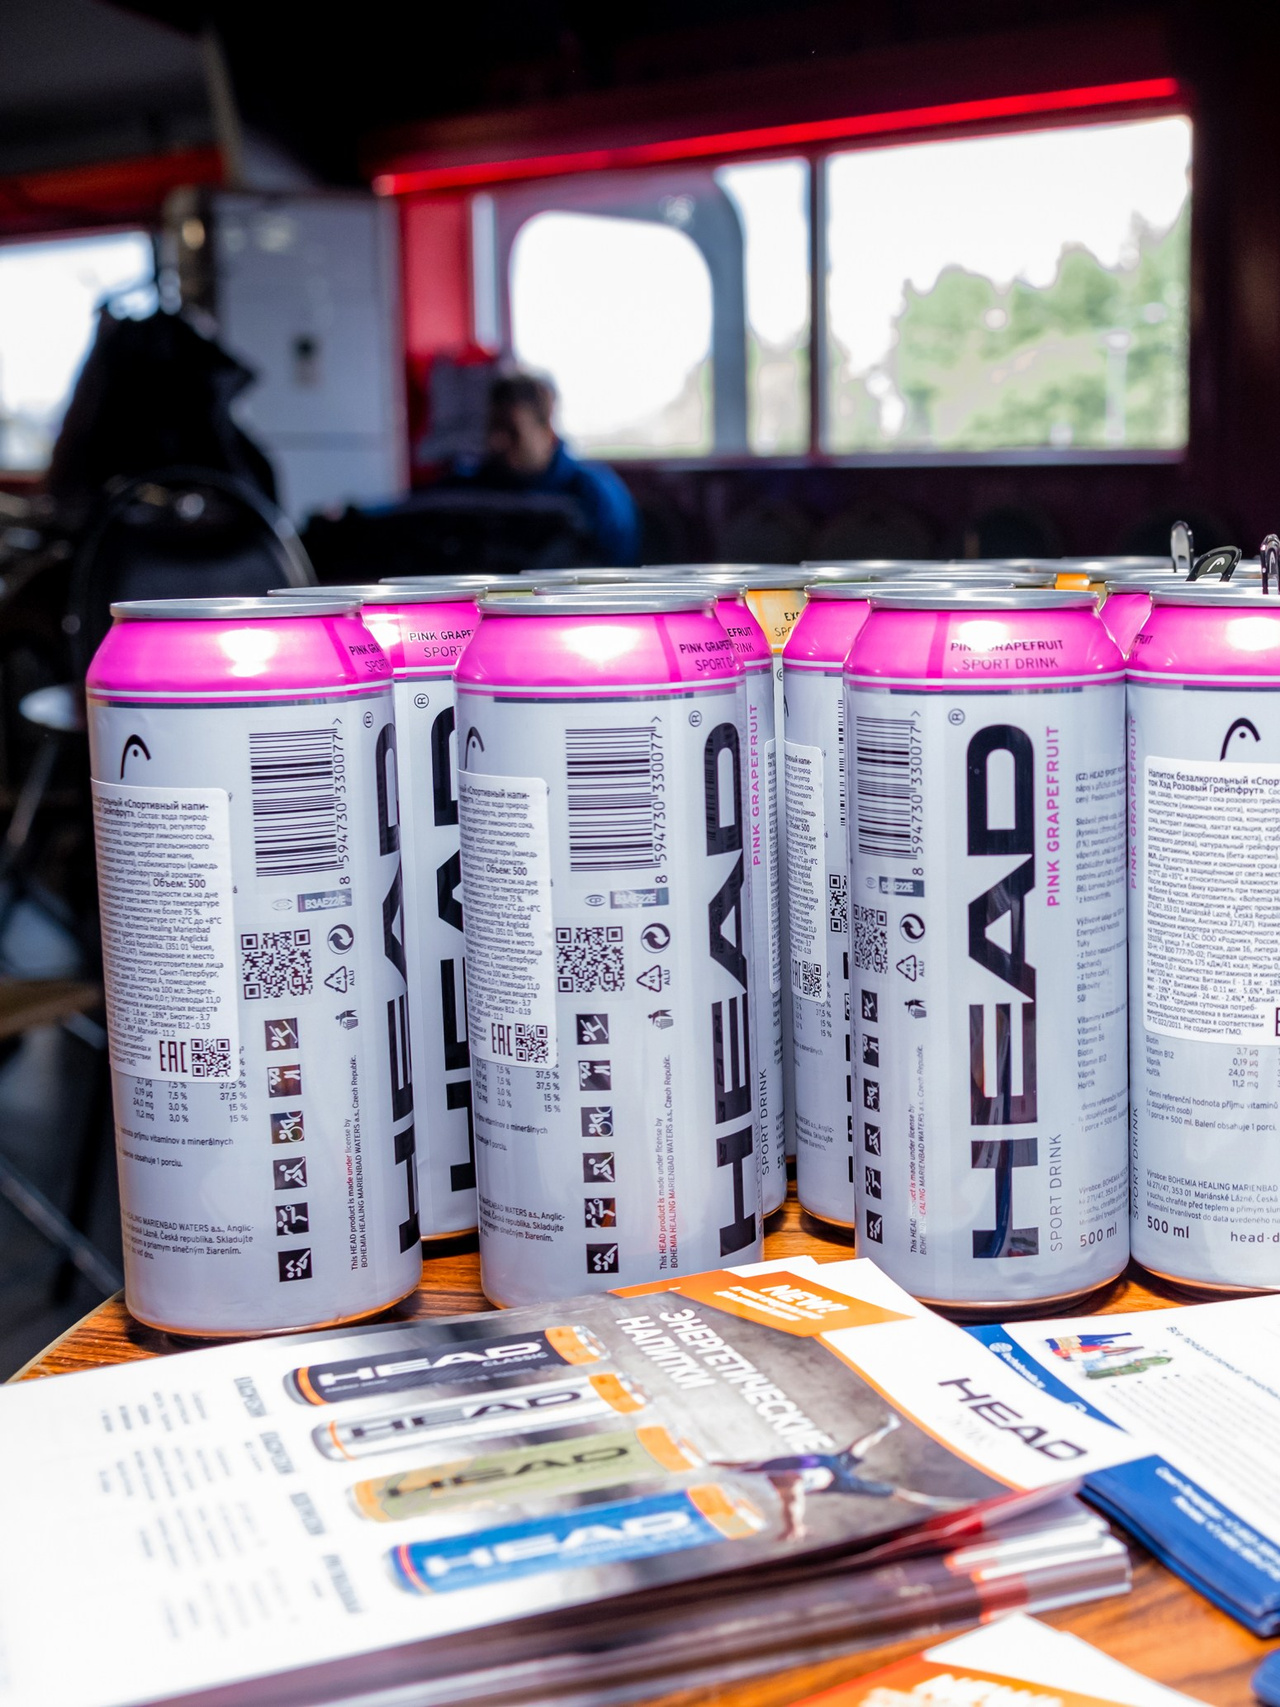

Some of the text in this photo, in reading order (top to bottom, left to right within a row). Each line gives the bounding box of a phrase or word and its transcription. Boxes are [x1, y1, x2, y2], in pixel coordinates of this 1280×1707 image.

[409, 631, 438, 643] PINK
[727, 626, 754, 638] EFRUIT
[349, 645, 368, 656] PINK
[679, 643, 705, 655] PINK
[695, 657, 726, 672] SPORT
[962, 656, 1059, 671] SPORT DRINK
[748, 704, 761, 866] PINK GRAPEFRUIT
[1148, 769, 1175, 780] Напиток
[1176, 772, 1248, 785] безалкогольный
[1148, 779, 1158, 787] ток
[1159, 780, 1172, 789] Хэд
[1173, 782, 1207, 792] Розовый
[332, 732, 350, 885] 8 594730 330077
[650, 732, 667, 884] 8 594730 330077
[910, 725, 924, 877] 8 594730 330077
[1046, 726, 1060, 907] PINK GRAPEFRUIT
[153, 878, 206, 889] Объем: 500
[704, 721, 760, 1258] HEAD
[966, 723, 1039, 1259] HEAD
[350, 1055, 358, 1085] Republic.
[663, 1055, 671, 1085] Republic.
[351, 1088, 359, 1108] Czech
[664, 1088, 672, 1108] Czech
[759, 1069, 771, 1176] SPORT DRINK
[655, 1128, 663, 1152] license
[355, 1156, 364, 1198] MARIENBAD
[667, 1155, 676, 1198] MARIENBAD
[1049, 1133, 1063, 1252] SPORT DRINK
[1168, 1174, 1197, 1187] BOHEMIA
[1198, 1180, 1230, 1191] HEALING
[1232, 1183, 1278, 1192] MARIENBAD
[349, 1205, 357, 1232] product
[358, 1200, 366, 1233] HEALING
[658, 1204, 667, 1232] product
[668, 1200, 676, 1233] HEALING
[1147, 1216, 1169, 1234] 500
[1173, 1226, 1190, 1239] ml
[360, 1234, 368, 1268] BOHEMIA
[669, 1235, 678, 1268] BOHEMIA
[1080, 1222, 1117, 1248] 500 ml
[659, 1256, 667, 1270] This
[317, 1341, 543, 1388] HEAD
[615, 1315, 717, 1390] НАПИТКИ
[659, 1308, 835, 1451] ЭНЕРГЕТИЧЕСКИЕ
[351, 1391, 582, 1438] HEAD
[938, 1376, 1088, 1462] HEAD
[388, 1445, 629, 1497] HEAD
[423, 1510, 691, 1578] HEAD
